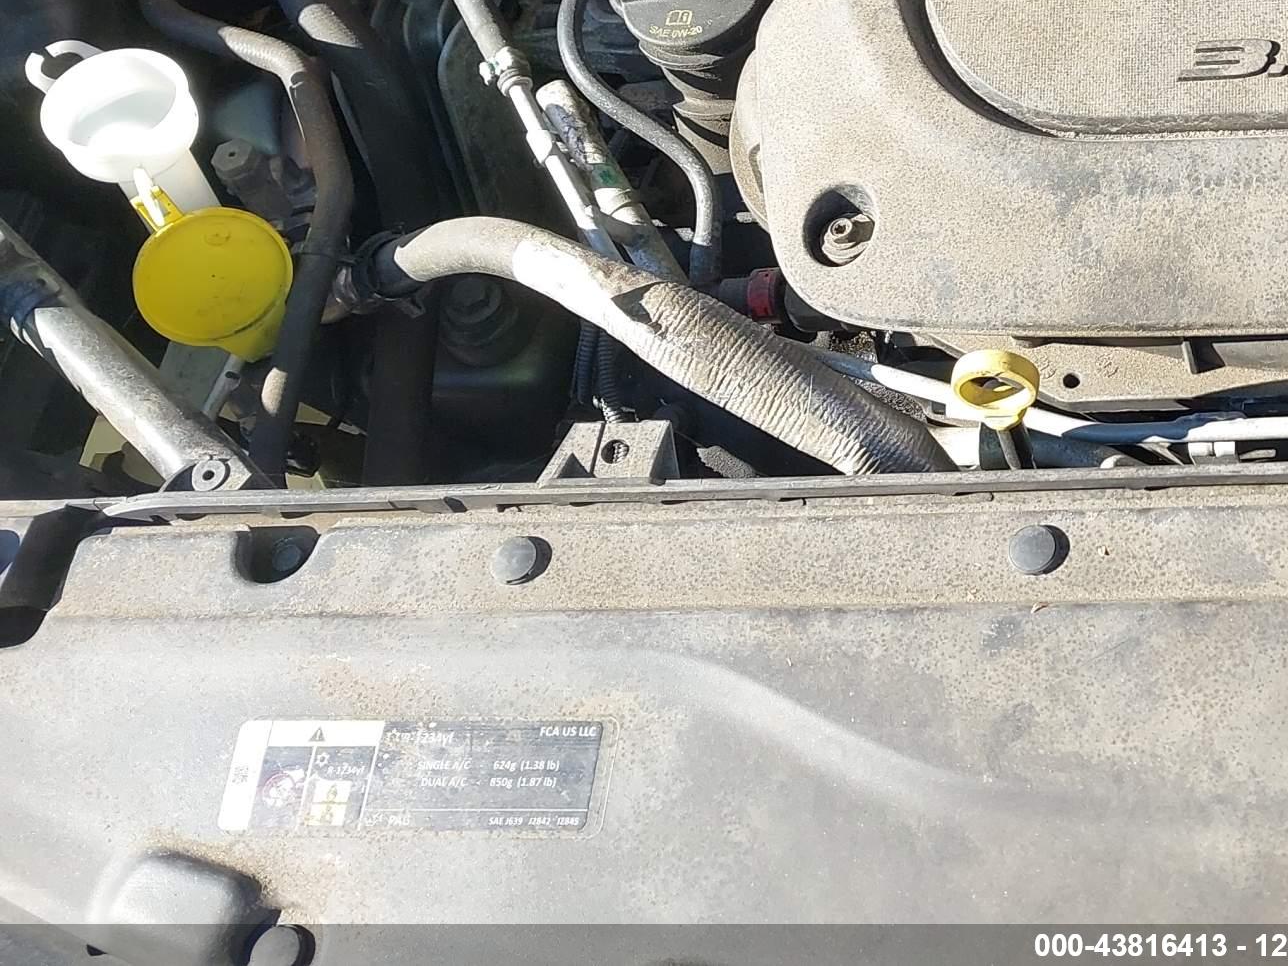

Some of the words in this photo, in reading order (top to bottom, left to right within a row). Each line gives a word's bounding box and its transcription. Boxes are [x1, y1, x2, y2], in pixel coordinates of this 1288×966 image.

[649, 25, 671, 38] SAE
[540, 726, 560, 737] FCA
[562, 726, 577, 737] US
[578, 726, 597, 737] LLC
[417, 760, 450, 770] SINGLE
[452, 759, 472, 770] A/C
[493, 760, 516, 772] 624g
[520, 759, 545, 772] (1.38
[546, 759, 560, 772] lb)
[421, 777, 448, 787] DUAL
[490, 777, 513, 789] 850g
[517, 777, 541, 789] (1.87
[543, 777, 557, 789] lb)
[505, 816, 523, 826] J639
